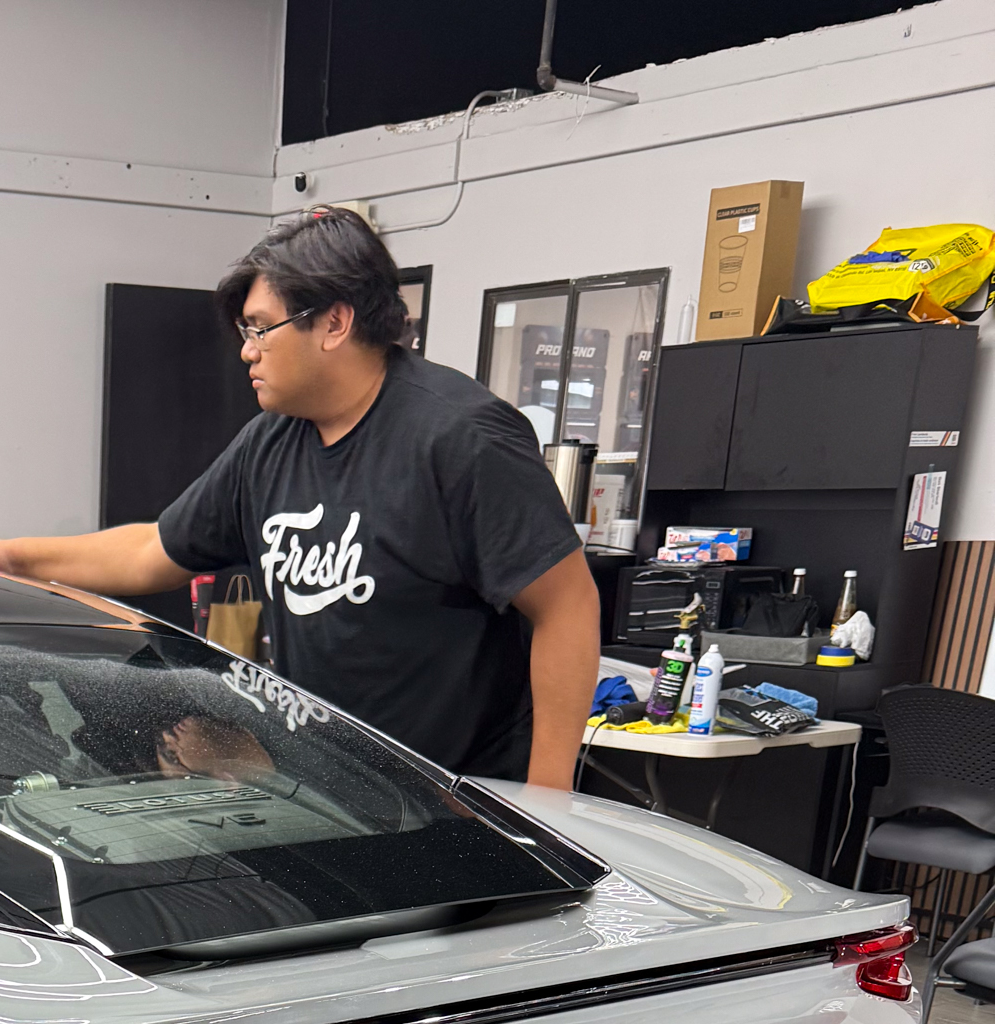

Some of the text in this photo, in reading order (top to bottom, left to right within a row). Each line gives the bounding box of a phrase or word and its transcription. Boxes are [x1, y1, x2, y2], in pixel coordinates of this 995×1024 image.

[260, 503, 376, 616] Fresh
[665, 659, 685, 674] 3D
[118, 791, 236, 810] LOTUS
[188, 812, 267, 830] V6
